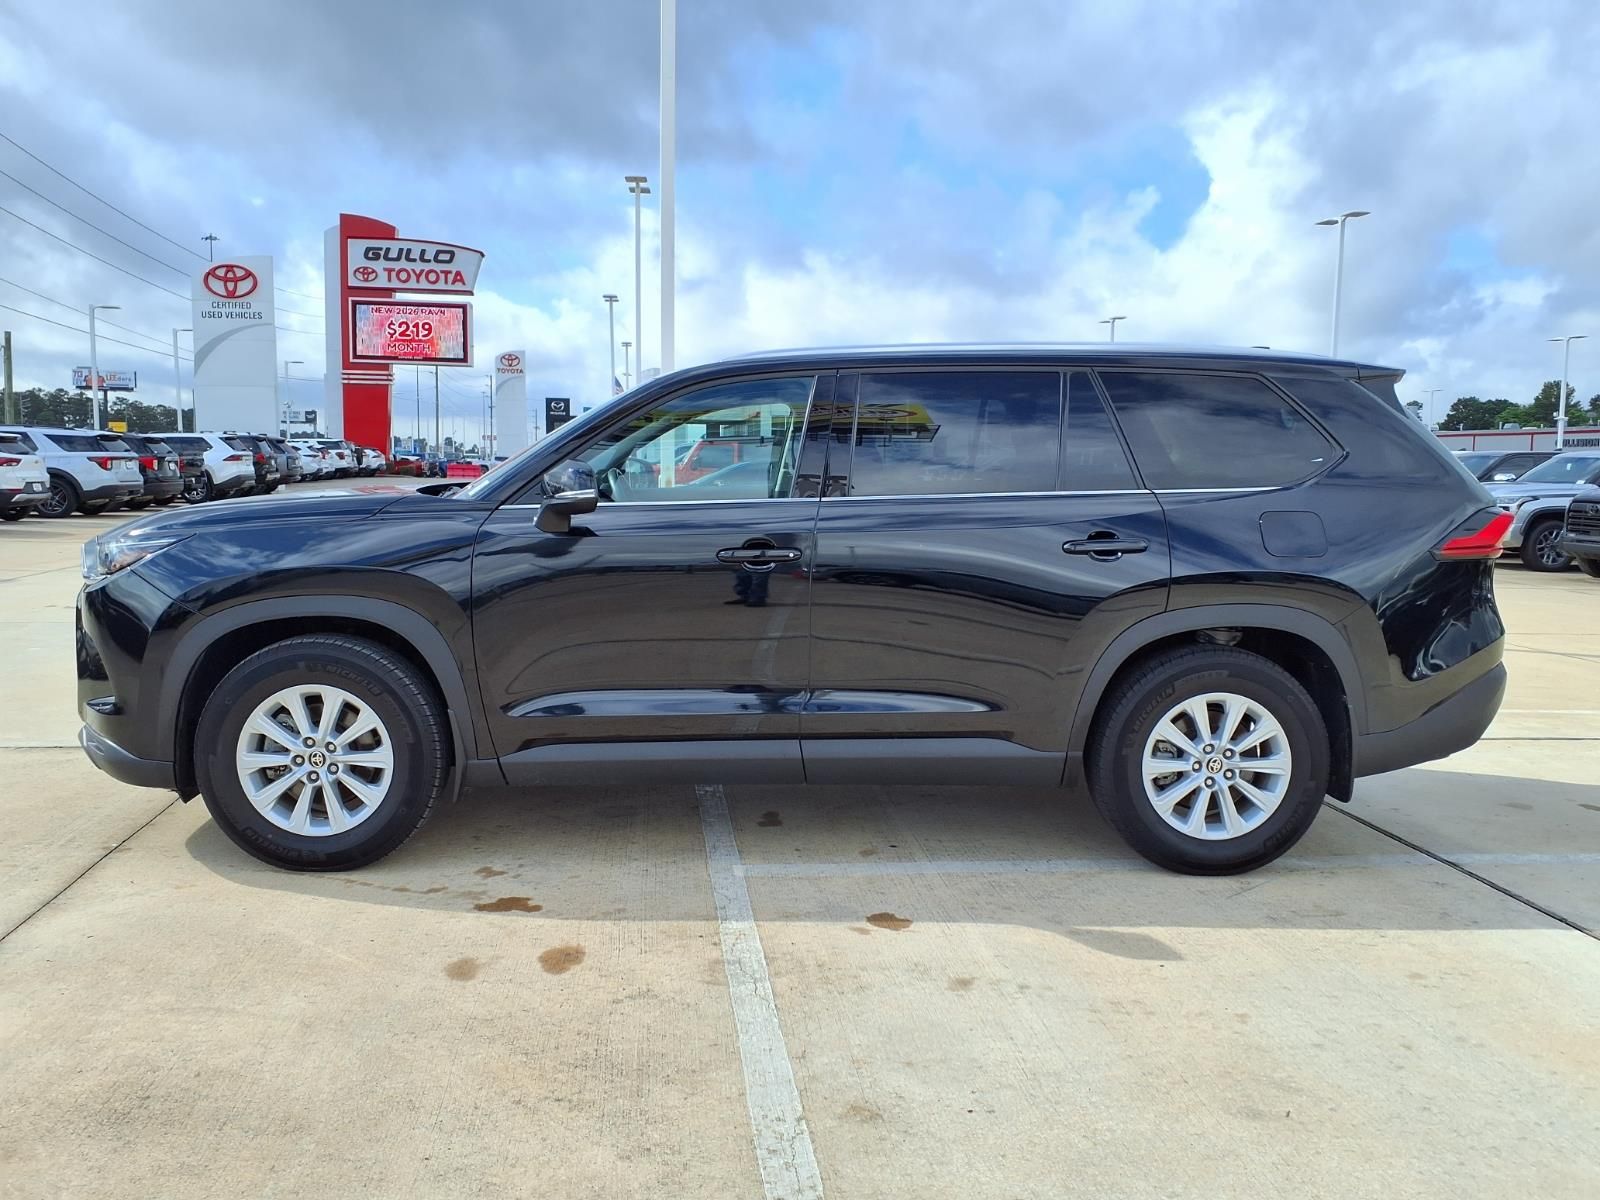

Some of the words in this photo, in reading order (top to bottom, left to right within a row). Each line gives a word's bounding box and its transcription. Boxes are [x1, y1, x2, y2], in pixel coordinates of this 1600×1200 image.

[364, 246, 456, 264] GULLO
[383, 267, 466, 286] TOYOTA
[211, 301, 252, 310] CERTIFIED
[371, 307, 394, 315] NEW
[396, 307, 419, 315] 2026
[201, 311, 223, 319] USED
[225, 311, 263, 320] VEHICLES
[387, 320, 433, 340] $219
[387, 342, 431, 353] MONTH
